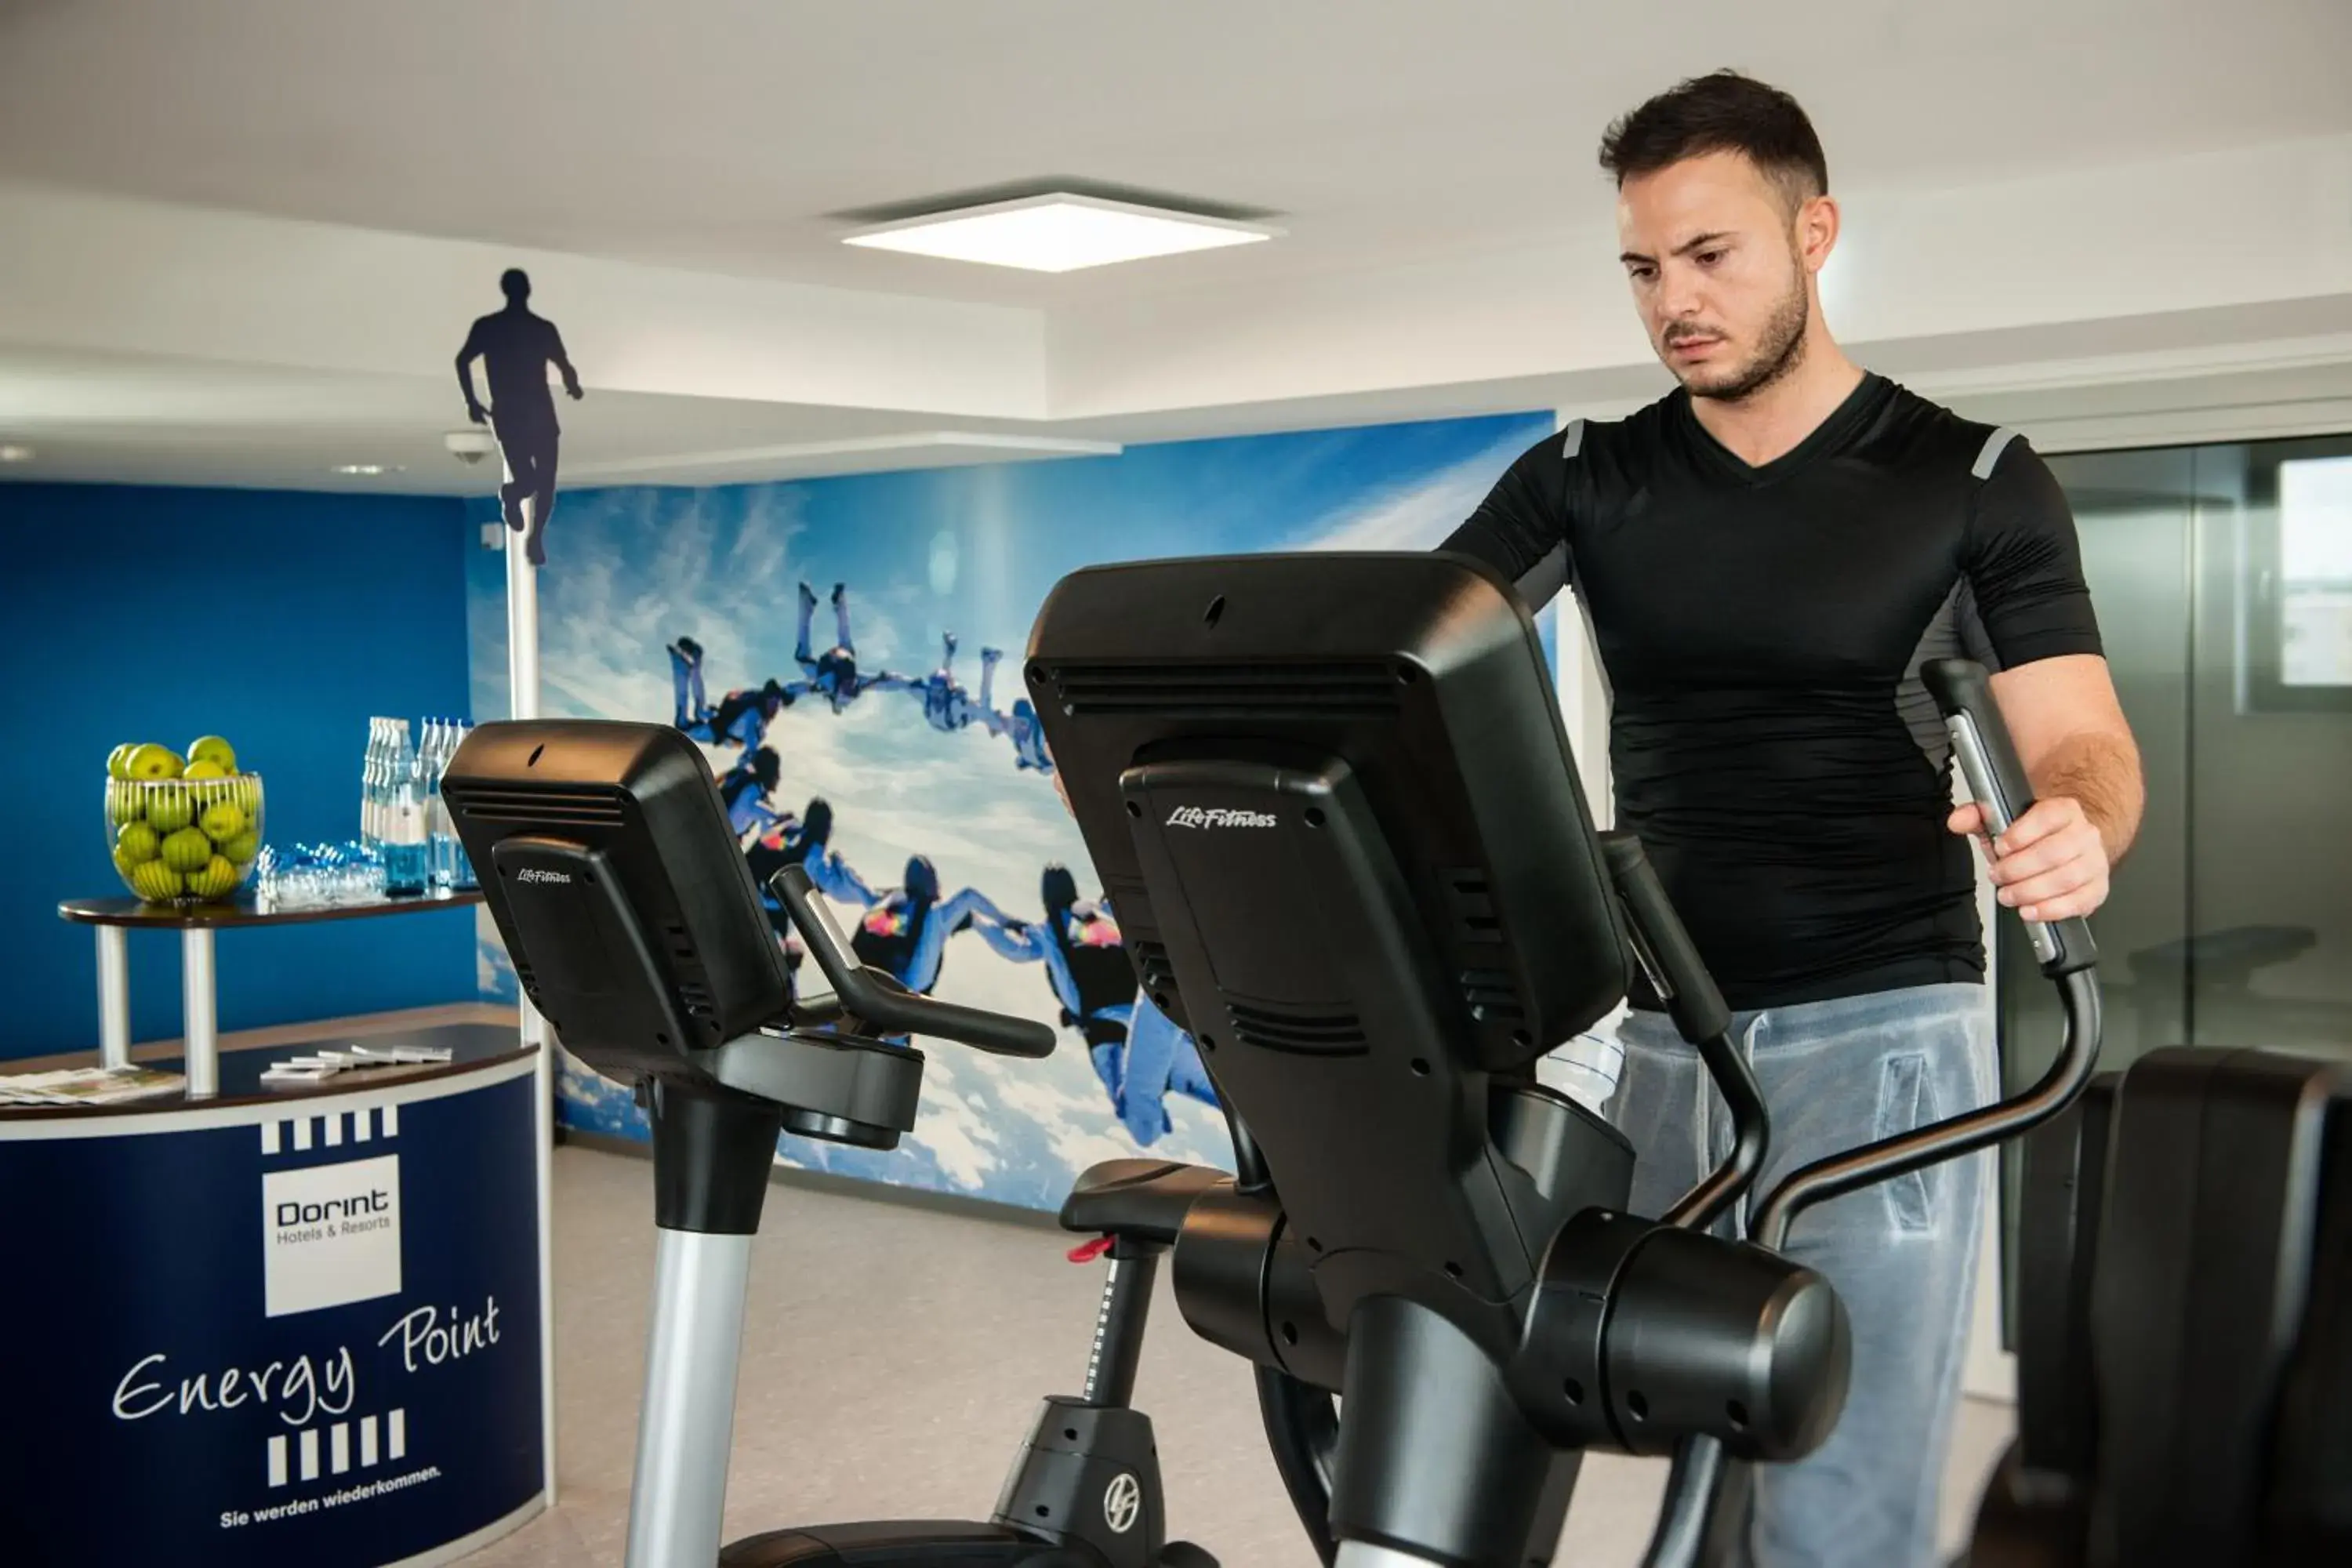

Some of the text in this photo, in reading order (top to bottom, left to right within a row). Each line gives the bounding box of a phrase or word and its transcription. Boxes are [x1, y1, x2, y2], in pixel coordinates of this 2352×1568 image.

[277, 1189, 389, 1228] Dorint
[277, 1216, 390, 1245] Hotels & Resorts
[111, 1295, 501, 1426] Energy Point
[220, 1465, 442, 1529] Sie werden wiederkommen.
